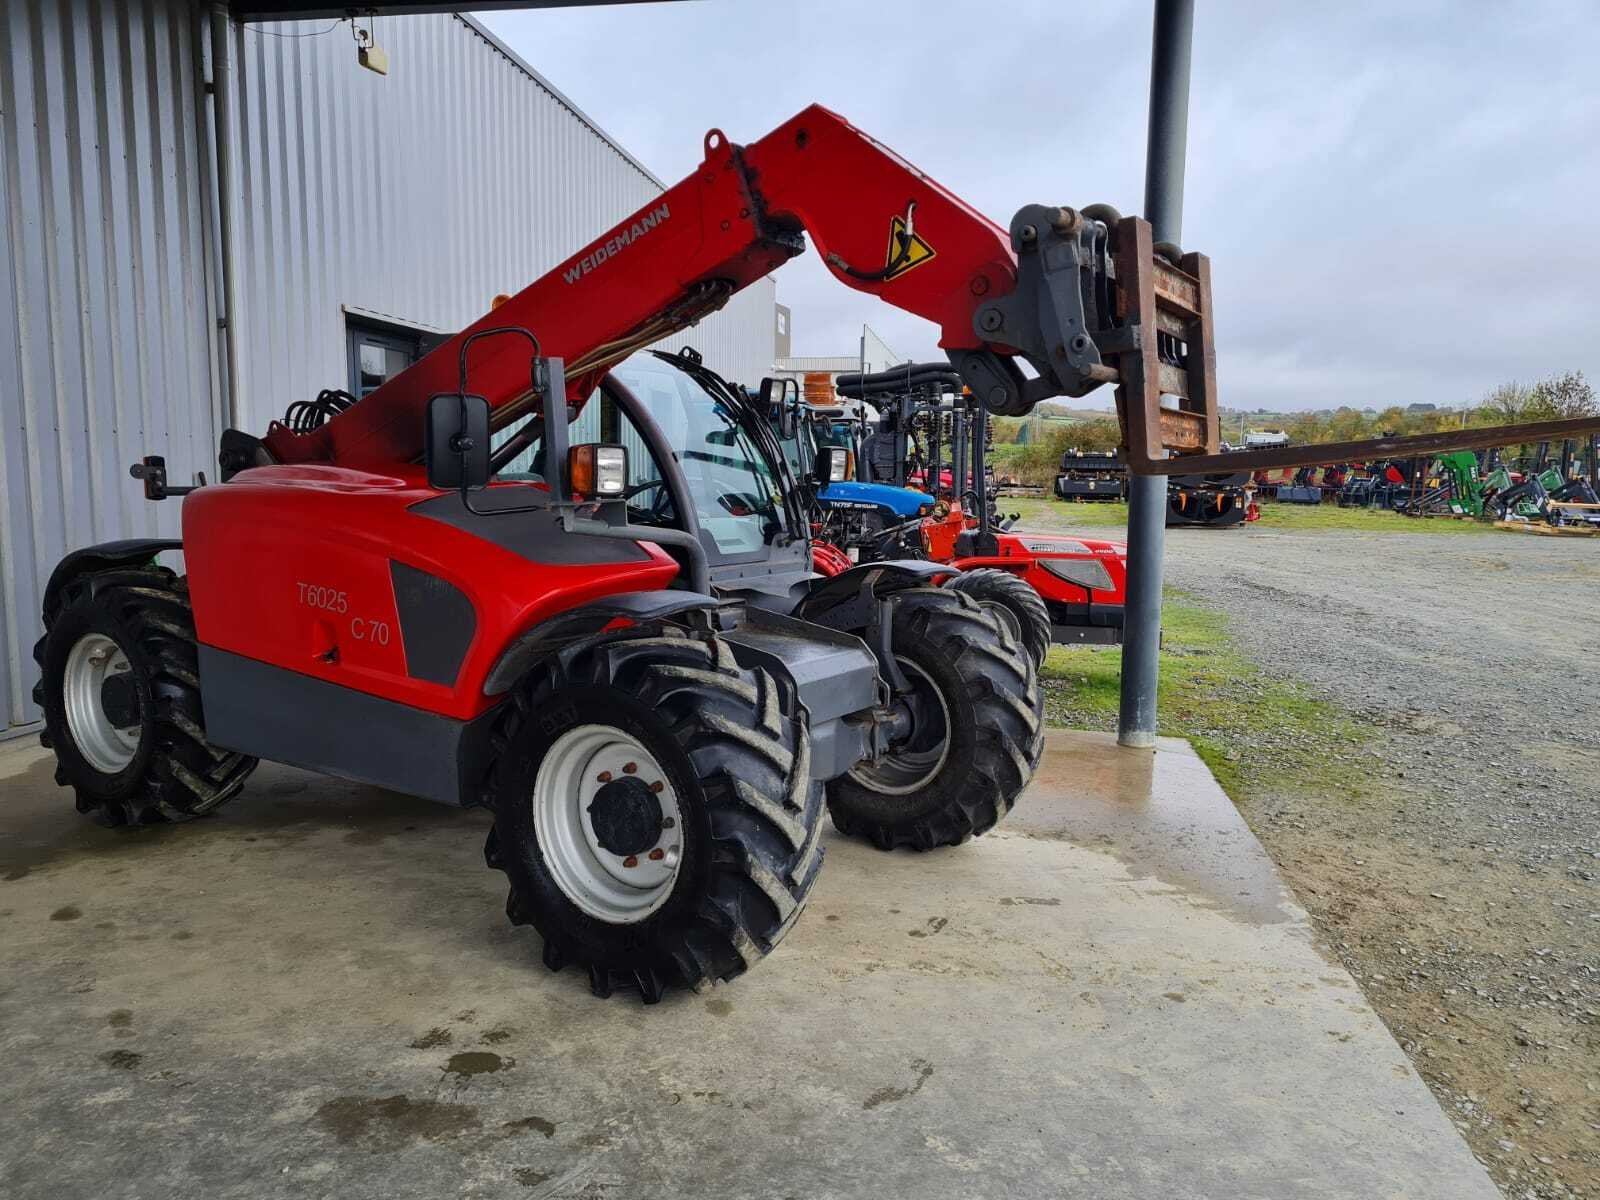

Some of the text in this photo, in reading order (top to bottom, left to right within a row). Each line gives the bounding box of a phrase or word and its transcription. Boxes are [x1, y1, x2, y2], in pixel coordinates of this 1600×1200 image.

[563, 203, 670, 284] WEIDEMANN
[297, 583, 347, 613] T6025
[352, 618, 389, 645] C 70
